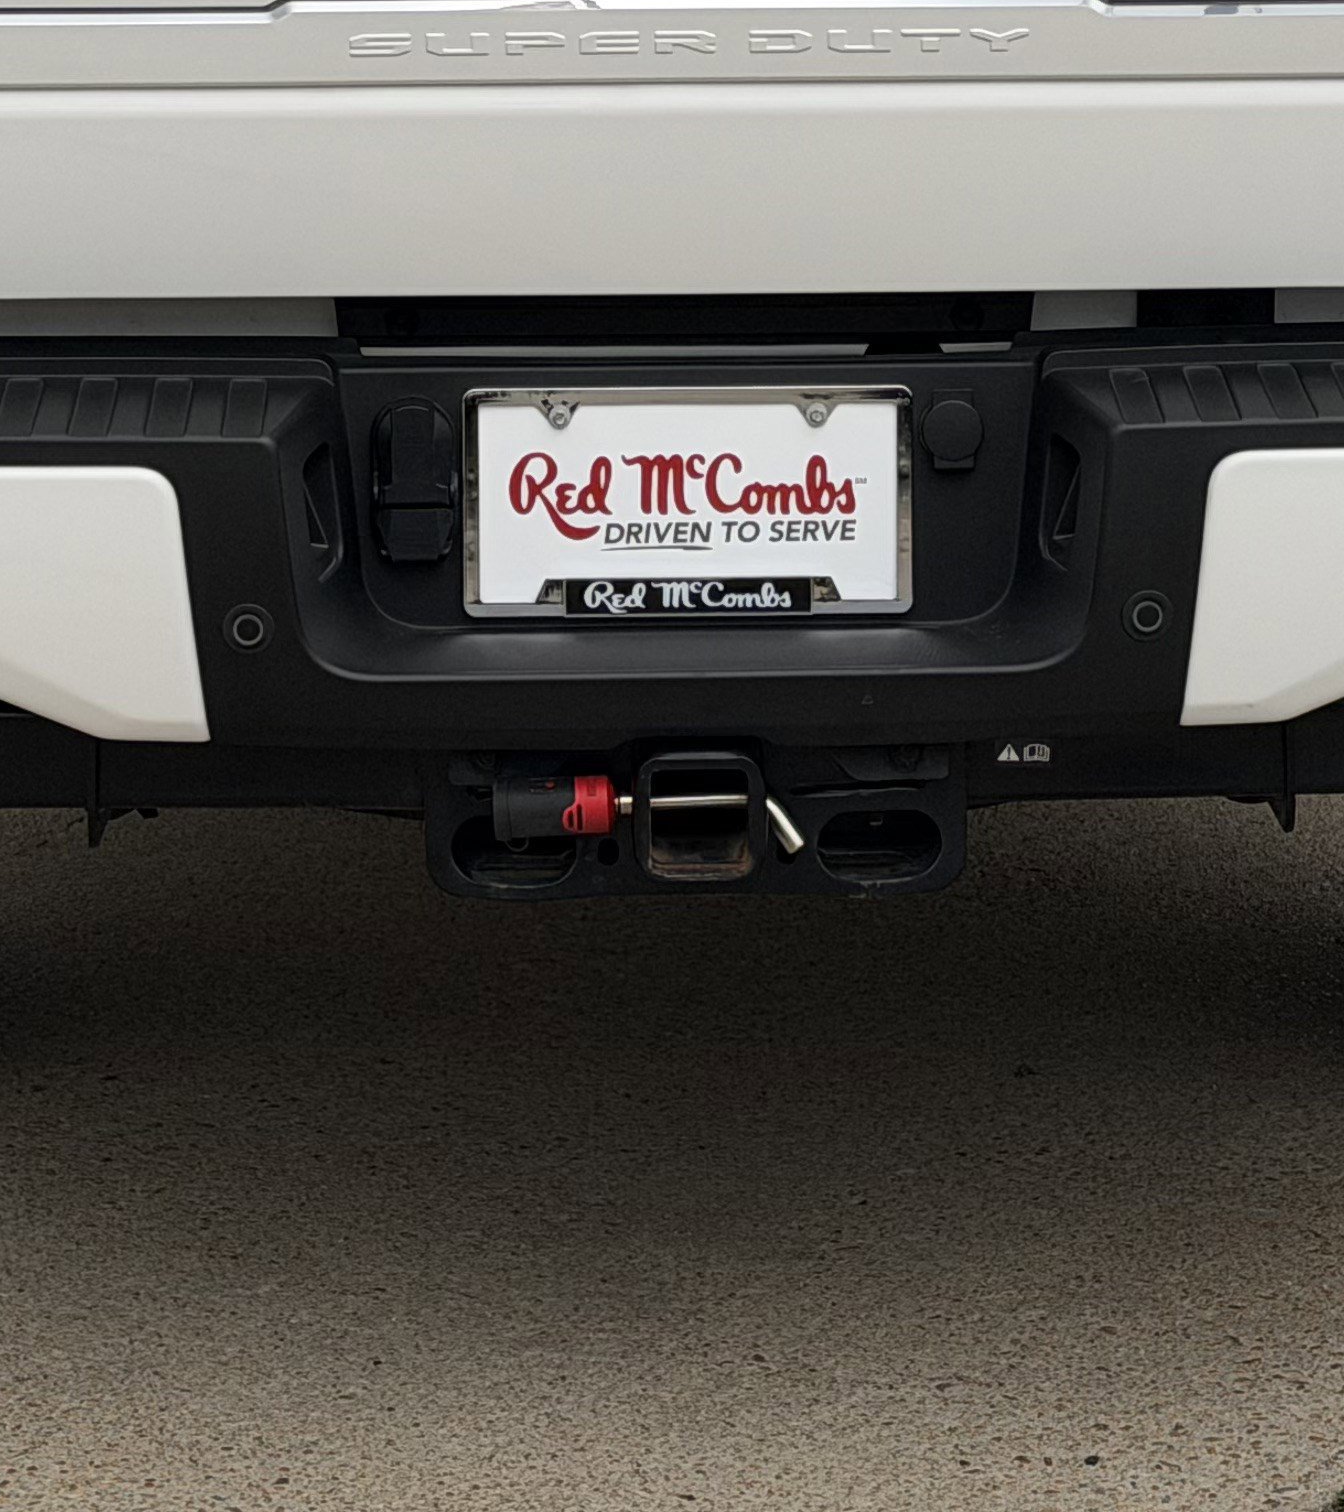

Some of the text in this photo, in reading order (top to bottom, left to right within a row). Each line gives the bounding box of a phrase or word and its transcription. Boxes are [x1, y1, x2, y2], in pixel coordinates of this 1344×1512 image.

[348, 27, 1031, 58] SUPER DUTY
[508, 452, 857, 541] Red McCombs
[604, 518, 857, 545] DRIVEN TO SERVE
[583, 580, 793, 615] Red McCombs
